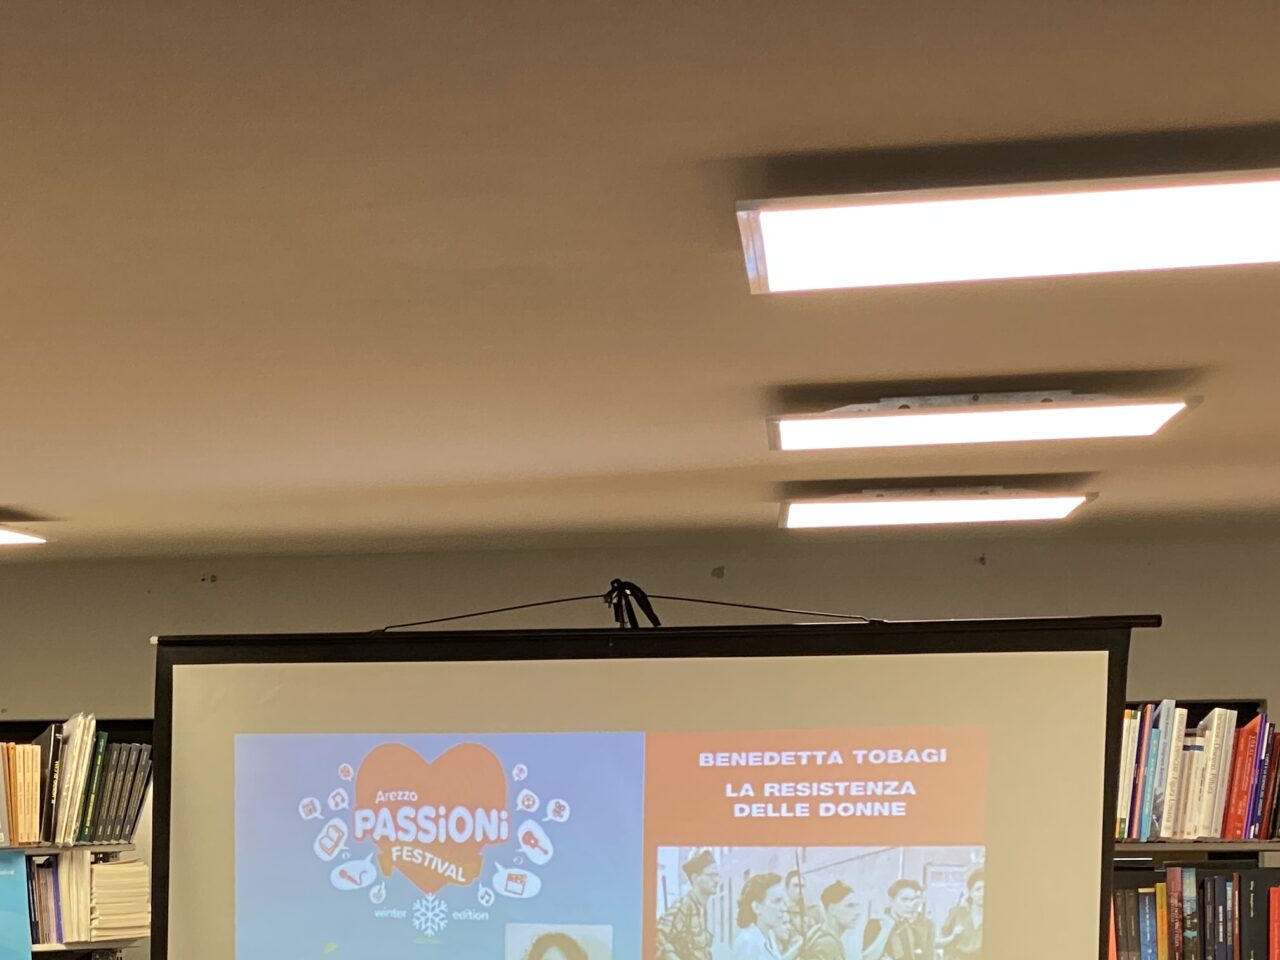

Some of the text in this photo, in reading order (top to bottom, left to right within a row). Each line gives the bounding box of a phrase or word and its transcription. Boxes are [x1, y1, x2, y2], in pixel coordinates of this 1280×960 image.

[698, 748, 947, 767] BENEDETTA TOBAGI
[375, 788, 419, 804] Arezzo
[725, 780, 917, 797] LA RESISTENZA
[733, 801, 907, 817] DELLE DONNE
[391, 845, 468, 884] FESTIVAL
[373, 908, 408, 920] winter
[451, 908, 490, 921] edition
